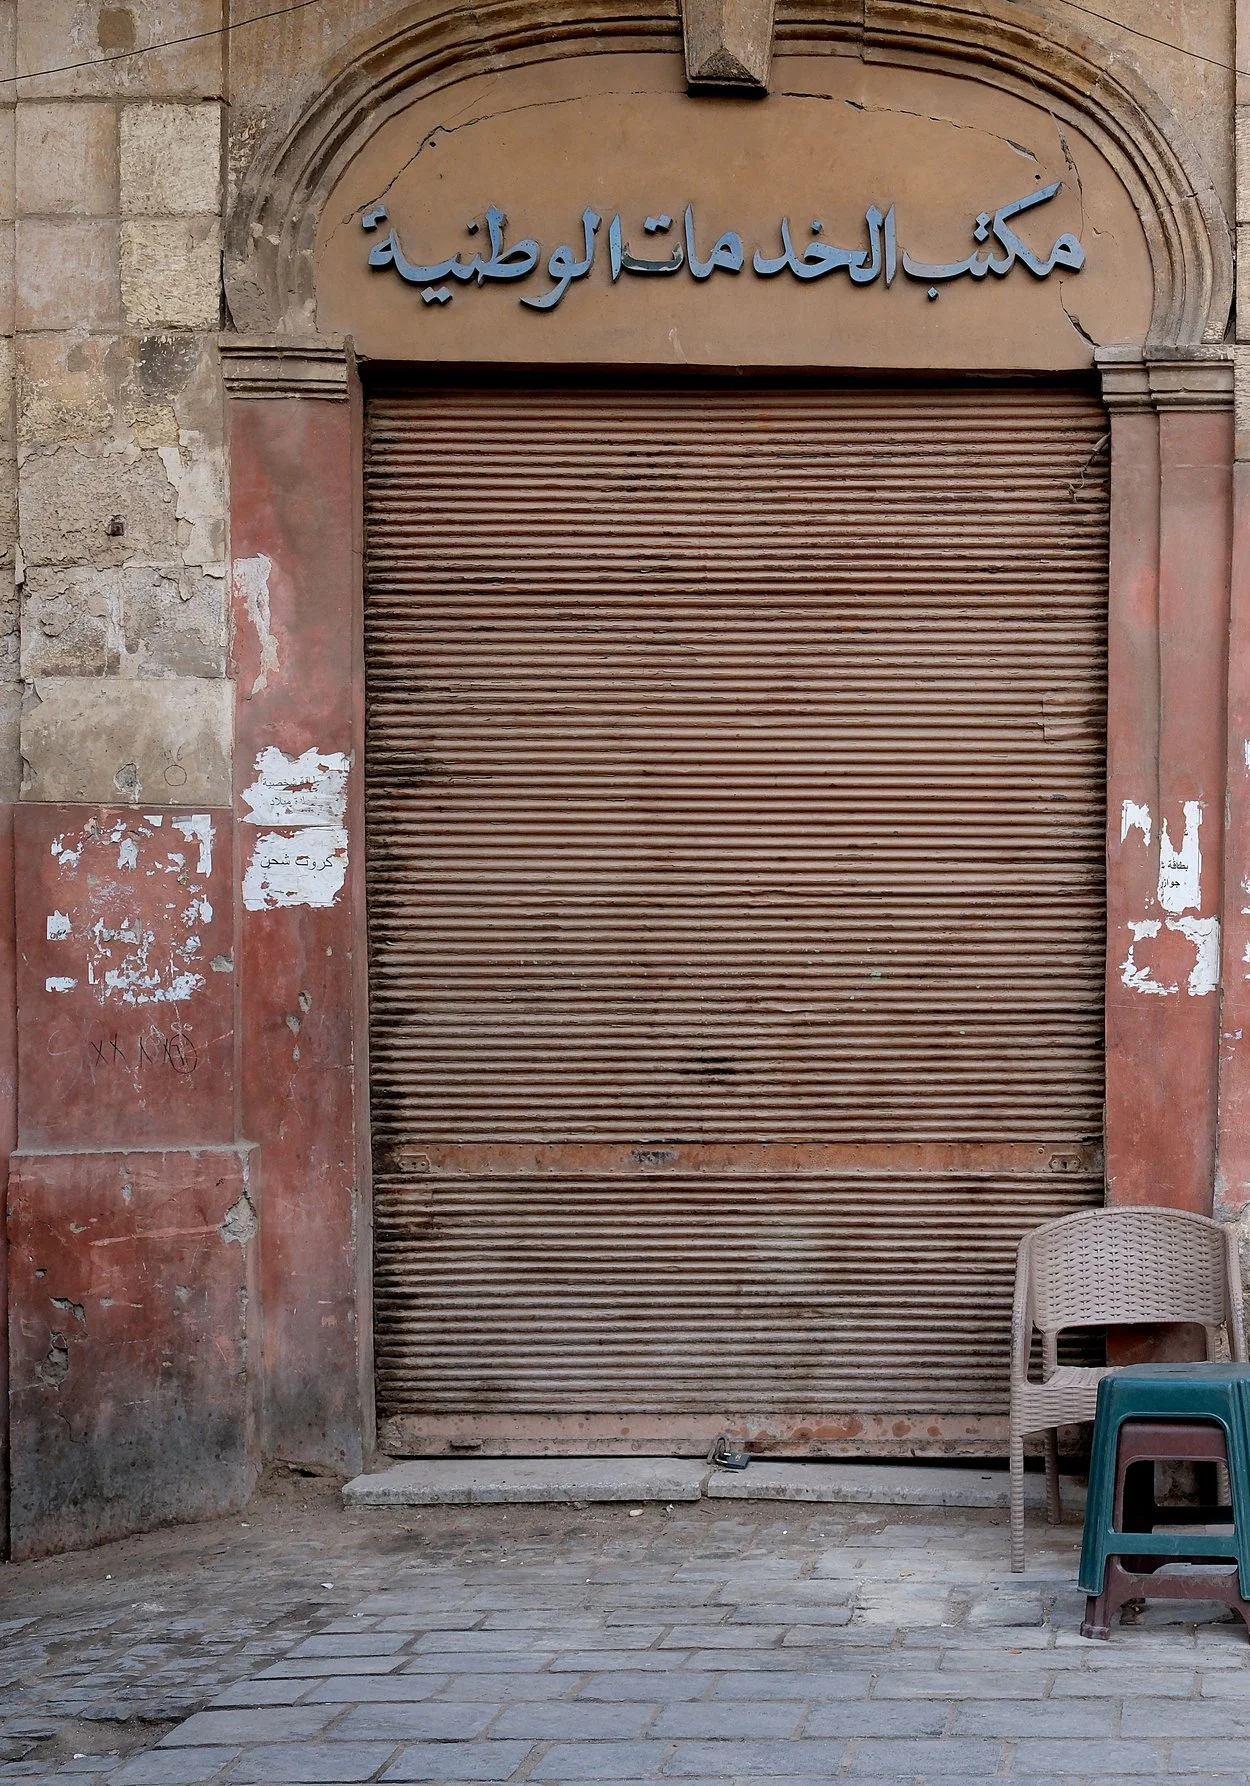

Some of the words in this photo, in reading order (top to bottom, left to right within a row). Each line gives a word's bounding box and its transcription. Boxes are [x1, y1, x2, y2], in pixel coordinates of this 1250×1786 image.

[361, 203, 623, 312] الوطنية
[620, 200, 898, 290] الخدمات
[902, 180, 1086, 302] مكتب
[260, 853, 291, 869] شحن
[294, 854, 333, 872] كروت
[1167, 857, 1189, 872] بطاقة
